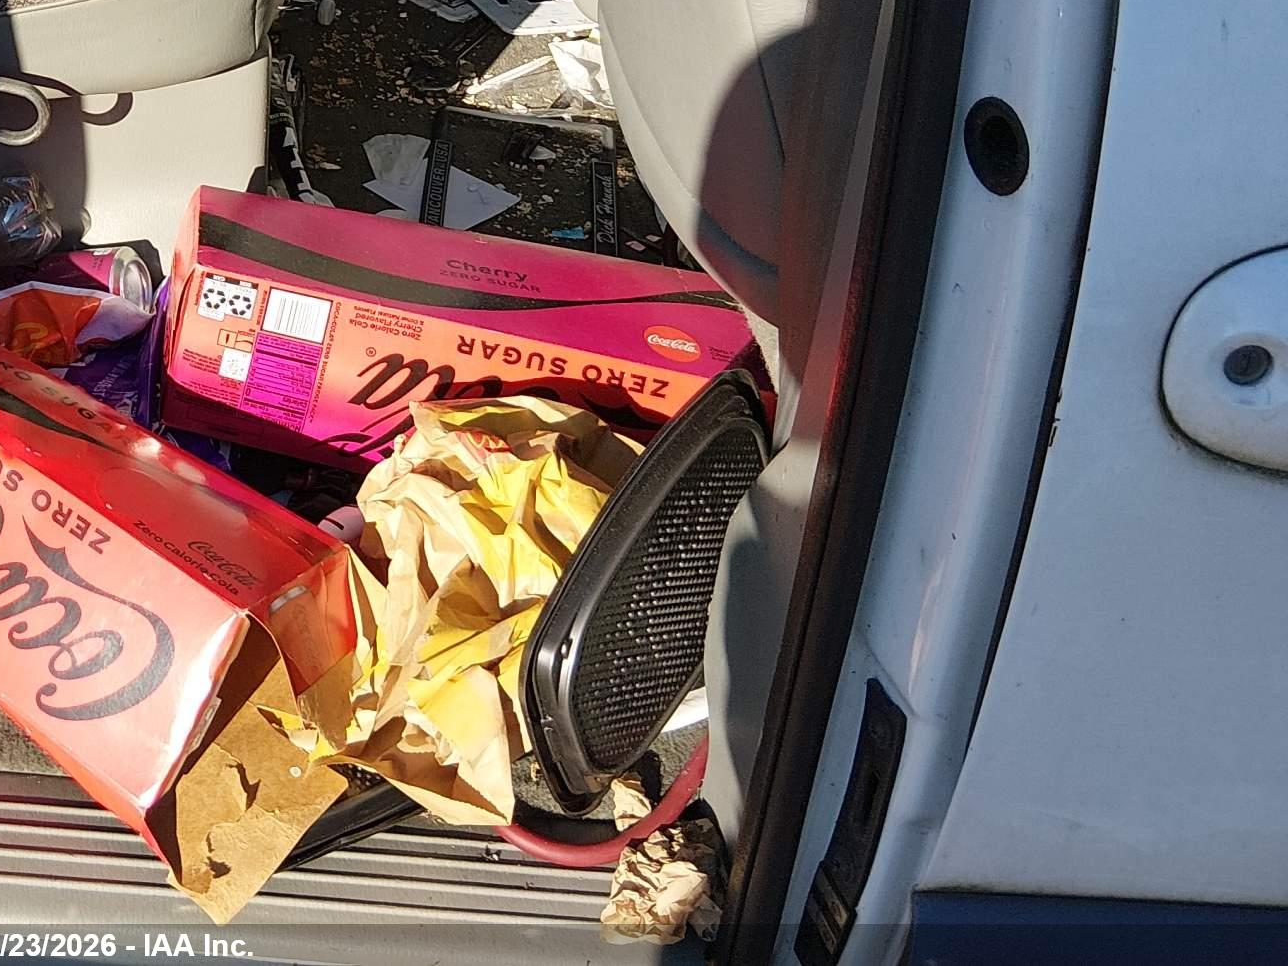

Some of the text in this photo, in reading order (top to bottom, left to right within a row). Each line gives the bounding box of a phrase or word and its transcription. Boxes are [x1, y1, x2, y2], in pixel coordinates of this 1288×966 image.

[437, 142, 450, 166] USA
[439, 269, 542, 294] ZERO SUGAR
[446, 259, 528, 282] Cherry
[349, 318, 421, 341] Zero Calorie Cola
[355, 312, 423, 333] Cherry Flavored
[647, 334, 698, 353] Coca-Cola
[456, 334, 669, 400] ZERO SUGAR
[30, 488, 114, 556] ZERO
[132, 520, 163, 545] Zero
[210, 572, 240, 597] Cola
[187, 539, 258, 591] Coca-Cola
